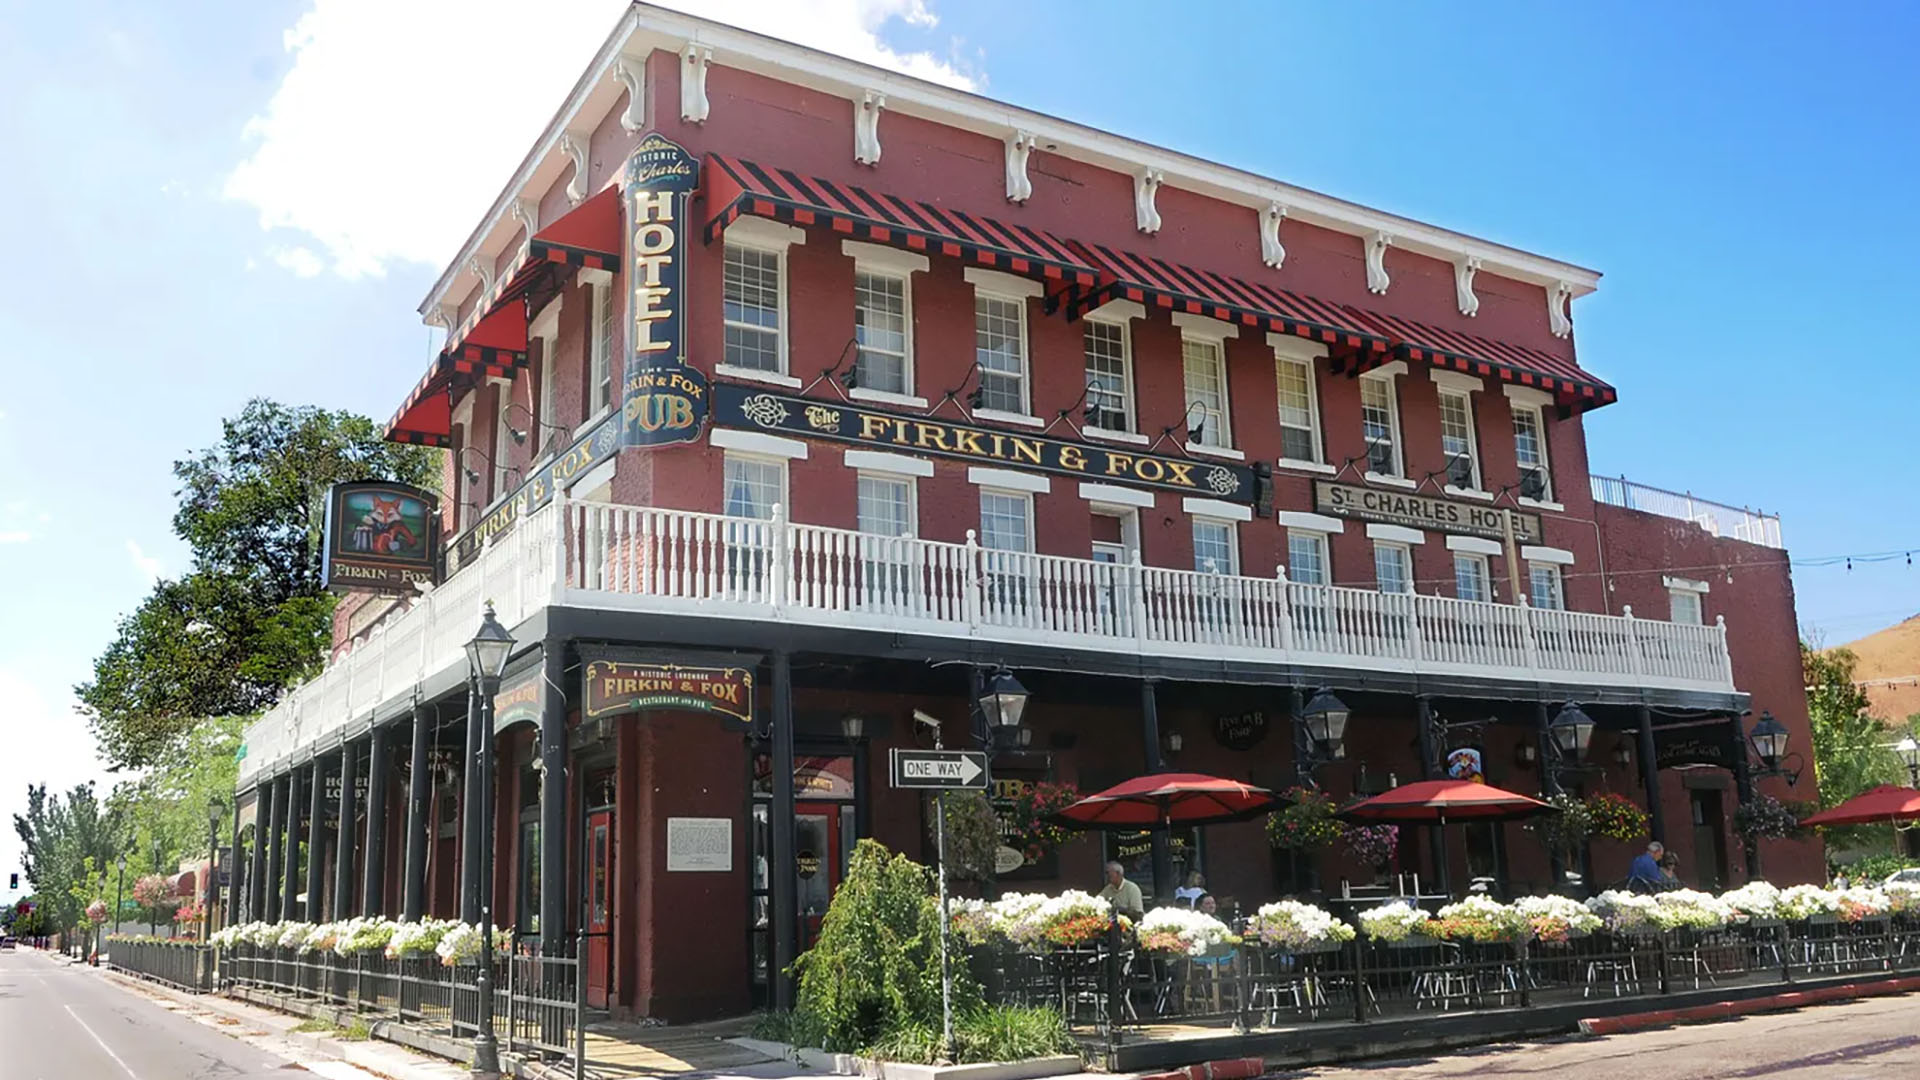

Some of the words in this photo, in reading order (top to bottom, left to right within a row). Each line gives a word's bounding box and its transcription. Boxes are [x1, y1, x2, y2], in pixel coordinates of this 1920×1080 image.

[638, 160, 691, 183] Charles
[633, 191, 675, 352] HOTEL
[656, 376, 667, 387] &
[669, 374, 704, 400] FOX
[623, 393, 695, 432] PUB
[804, 405, 841, 434] The
[858, 413, 1045, 465] FIRKIN
[1059, 445, 1089, 471] &
[1105, 452, 1197, 487] FOX
[1363, 491, 1459, 524] CHARLES
[333, 563, 388, 580] FIRKIN
[603, 677, 673, 699] FIRKIN
[680, 681, 694, 692] &
[701, 682, 738, 705] FOX
[906, 762, 931, 775] ONE
[937, 762, 963, 776] WAY
